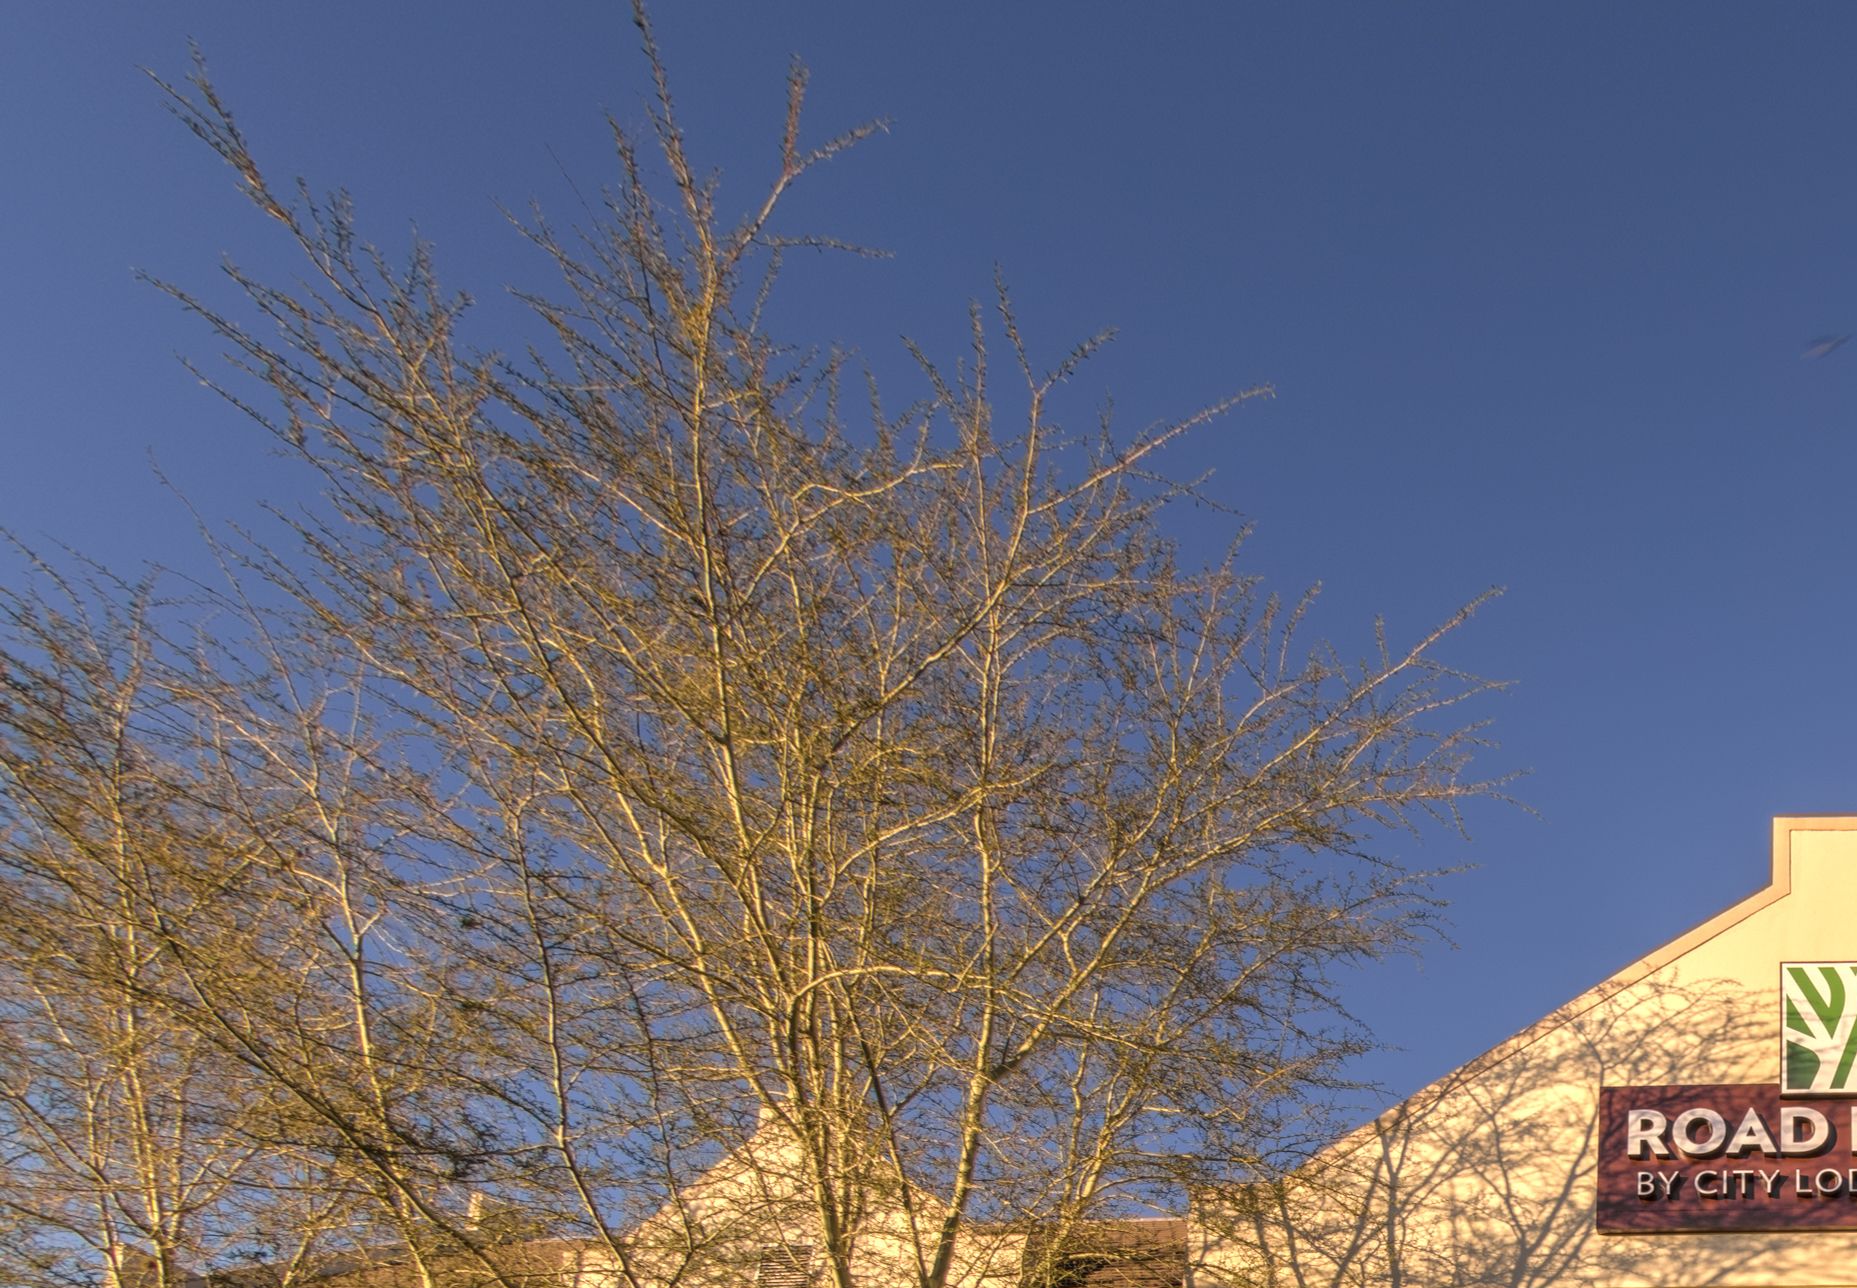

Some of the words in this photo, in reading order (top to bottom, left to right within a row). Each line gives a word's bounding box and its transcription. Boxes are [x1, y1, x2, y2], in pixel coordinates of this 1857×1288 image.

[1627, 1107, 1830, 1154] ROAD
[1637, 1171, 1679, 1196] BY
[1694, 1169, 1780, 1196] CITY
